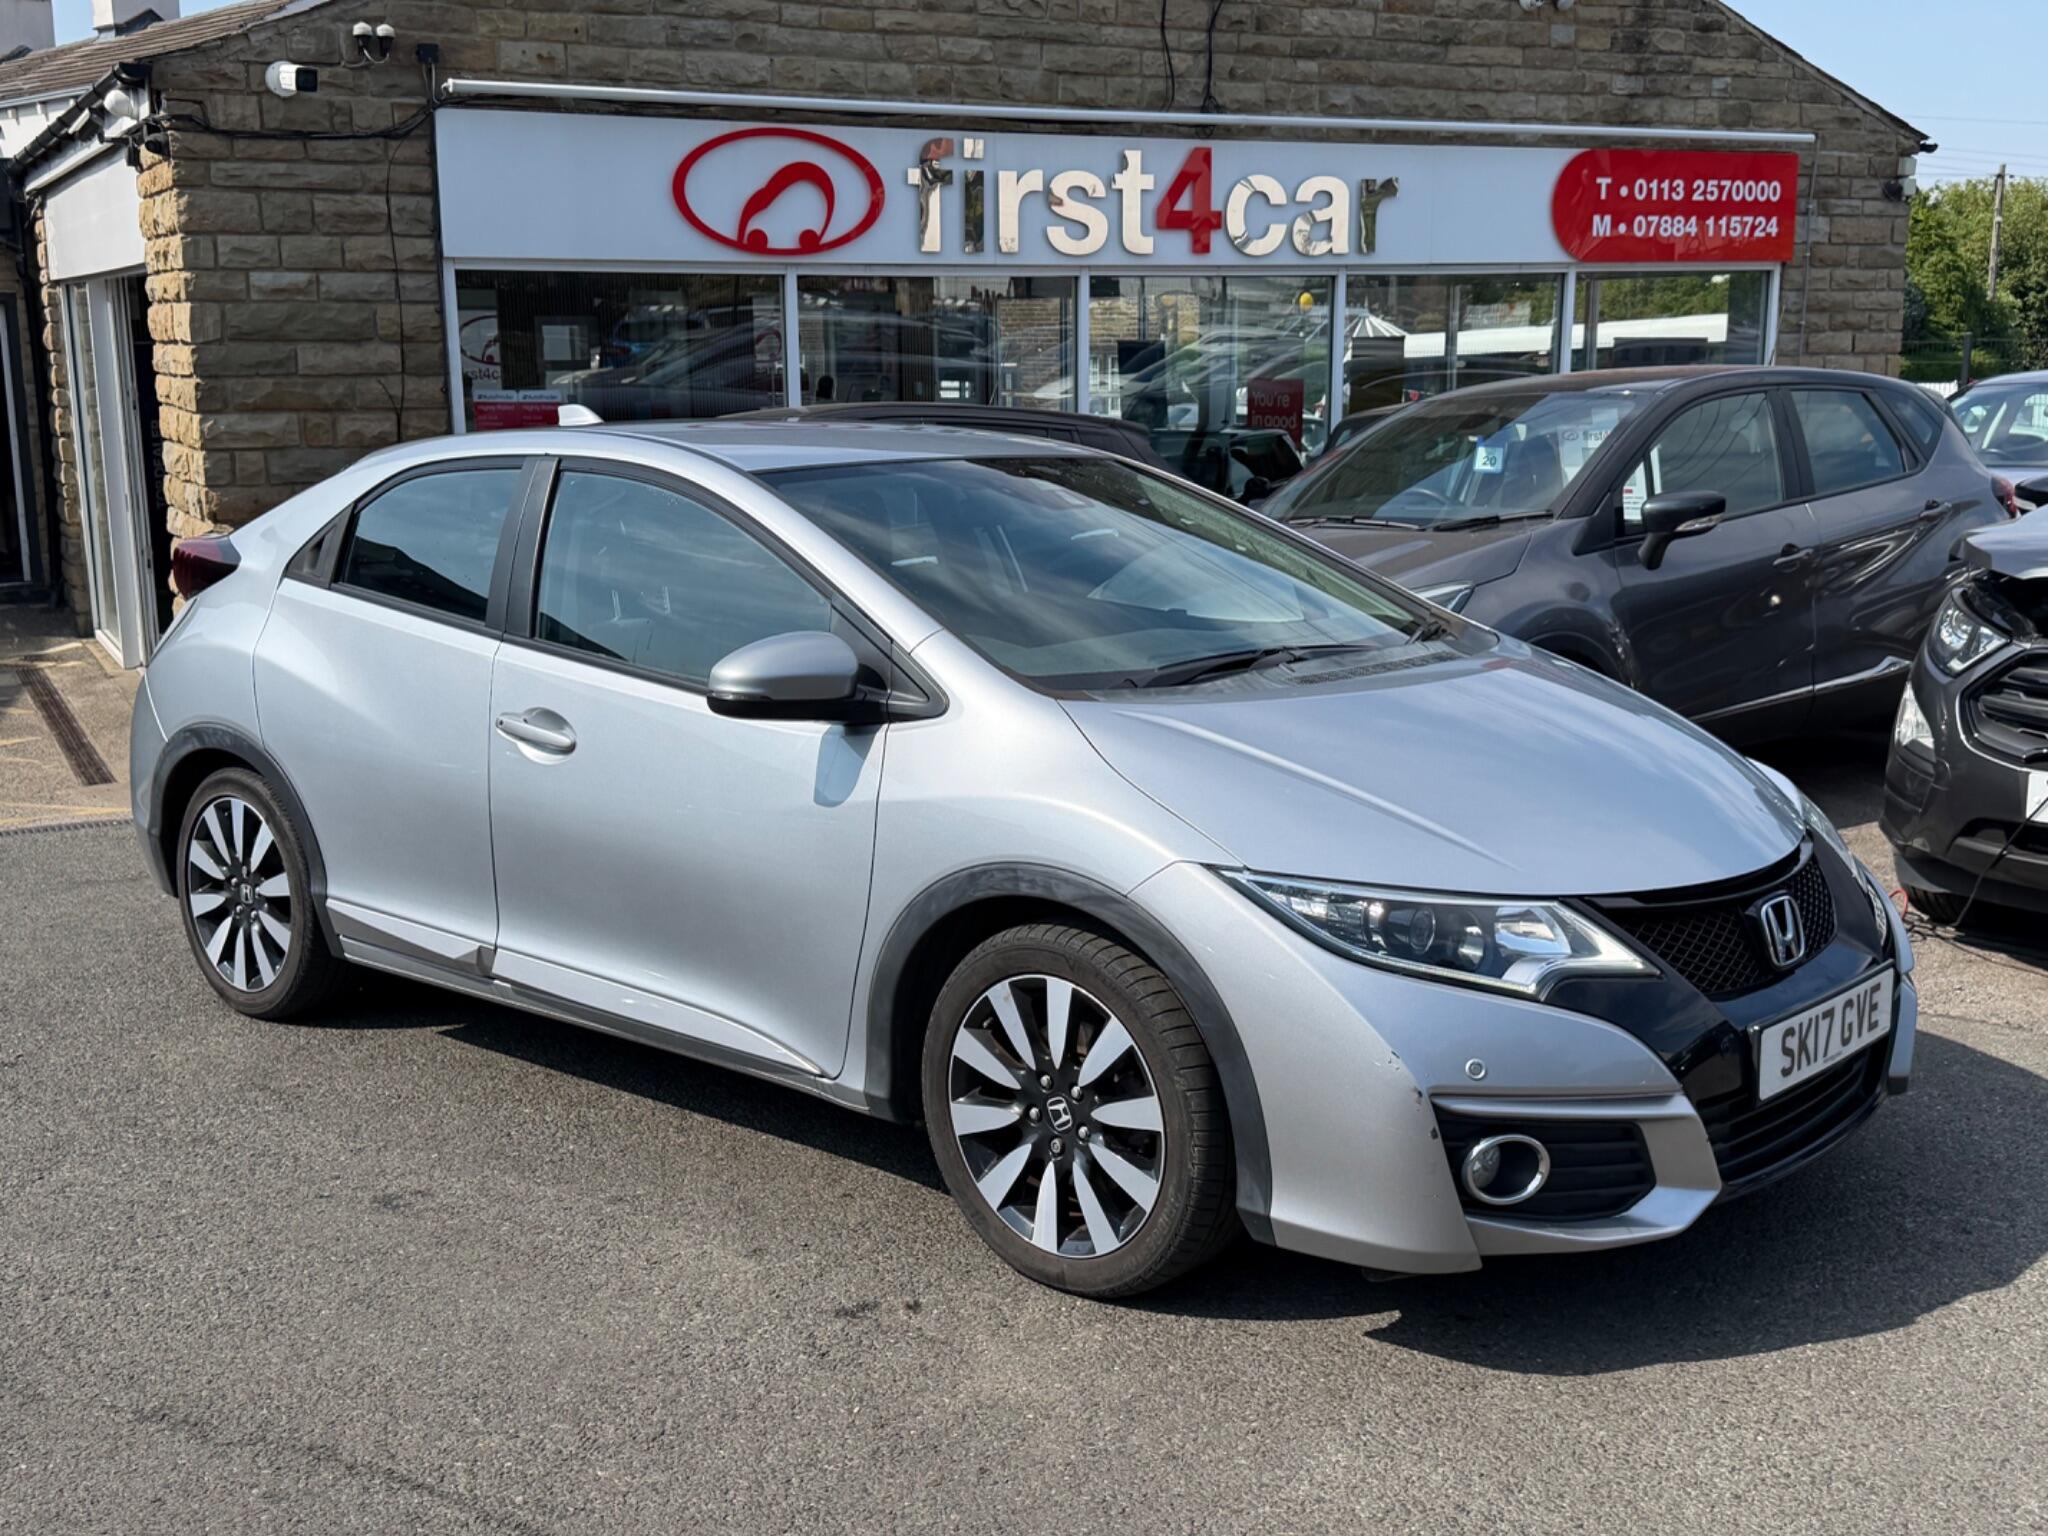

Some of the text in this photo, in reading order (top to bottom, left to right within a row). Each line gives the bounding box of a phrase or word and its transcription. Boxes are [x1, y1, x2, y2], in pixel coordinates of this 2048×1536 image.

[908, 137, 1399, 257] first4car
[1595, 177, 1781, 202] T 0113 2570000
[1592, 214, 1778, 237] M 07884 115724
[1482, 455, 1497, 468] 20
[1780, 982, 1881, 1078] SK17 GVE
